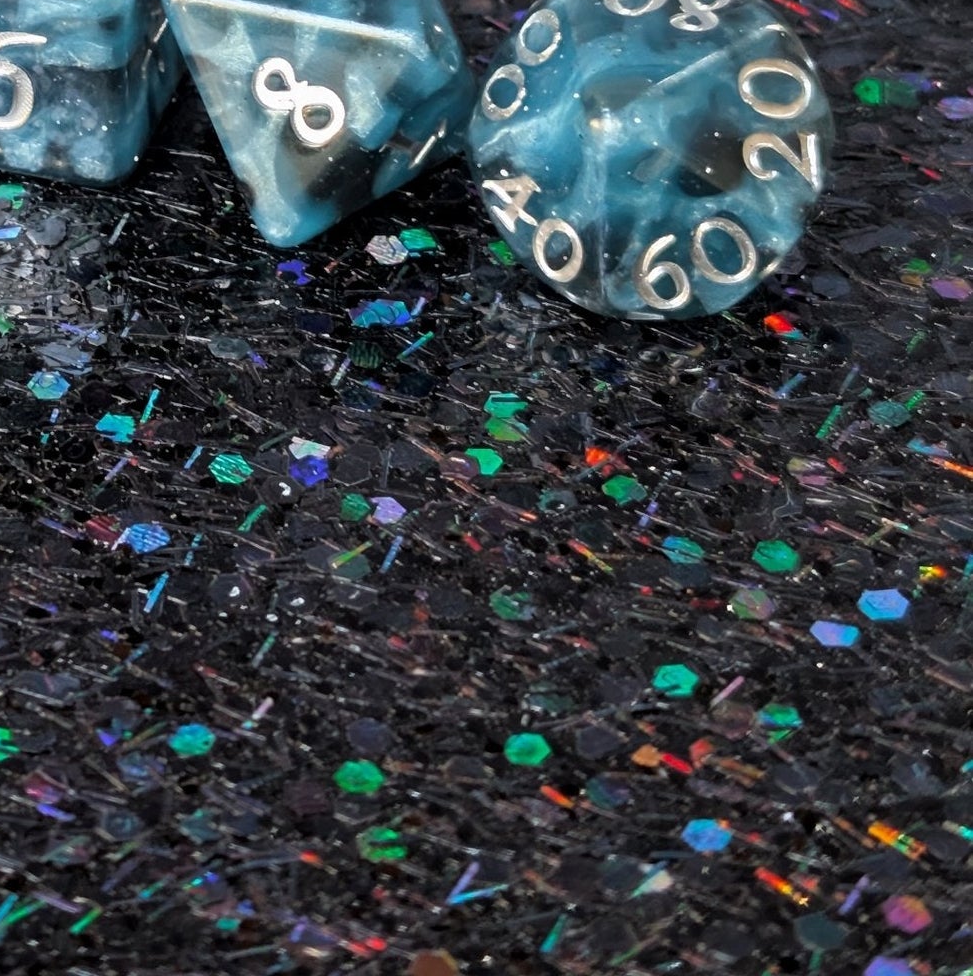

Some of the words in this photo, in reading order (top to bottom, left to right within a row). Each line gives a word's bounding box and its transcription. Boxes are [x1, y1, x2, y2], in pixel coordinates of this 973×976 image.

[251, 55, 346, 149] 8
[481, 8, 562, 122] 00
[737, 58, 822, 192] 20
[481, 174, 584, 283] 40
[632, 215, 758, 310] 60
